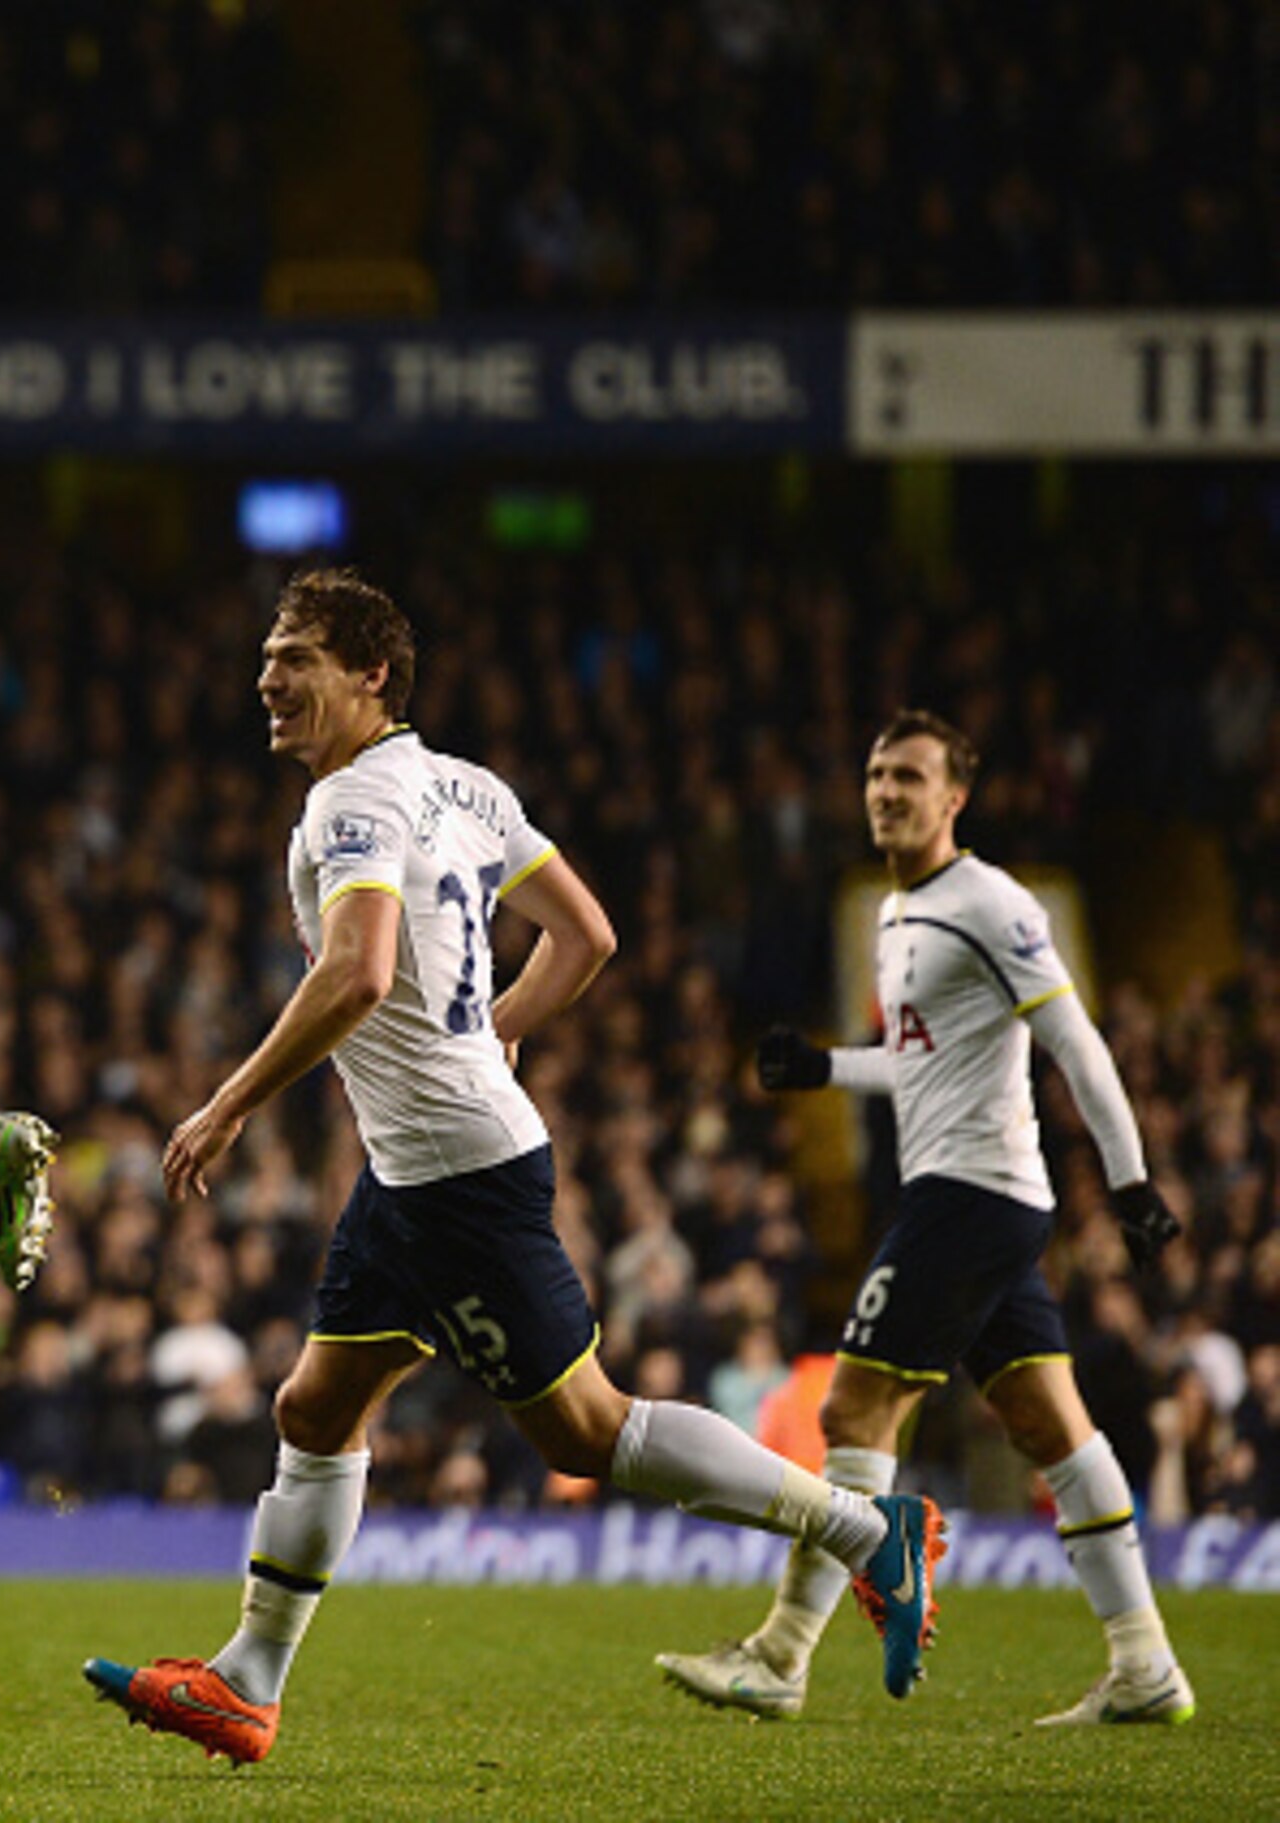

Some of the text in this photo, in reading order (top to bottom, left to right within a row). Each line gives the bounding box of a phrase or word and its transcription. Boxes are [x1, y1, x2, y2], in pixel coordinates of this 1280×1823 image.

[86, 342, 124, 418] I
[140, 340, 355, 421] LOVE
[388, 341, 542, 420] THE
[856, 1265, 897, 1321] 6
[433, 1296, 509, 1369] 15
